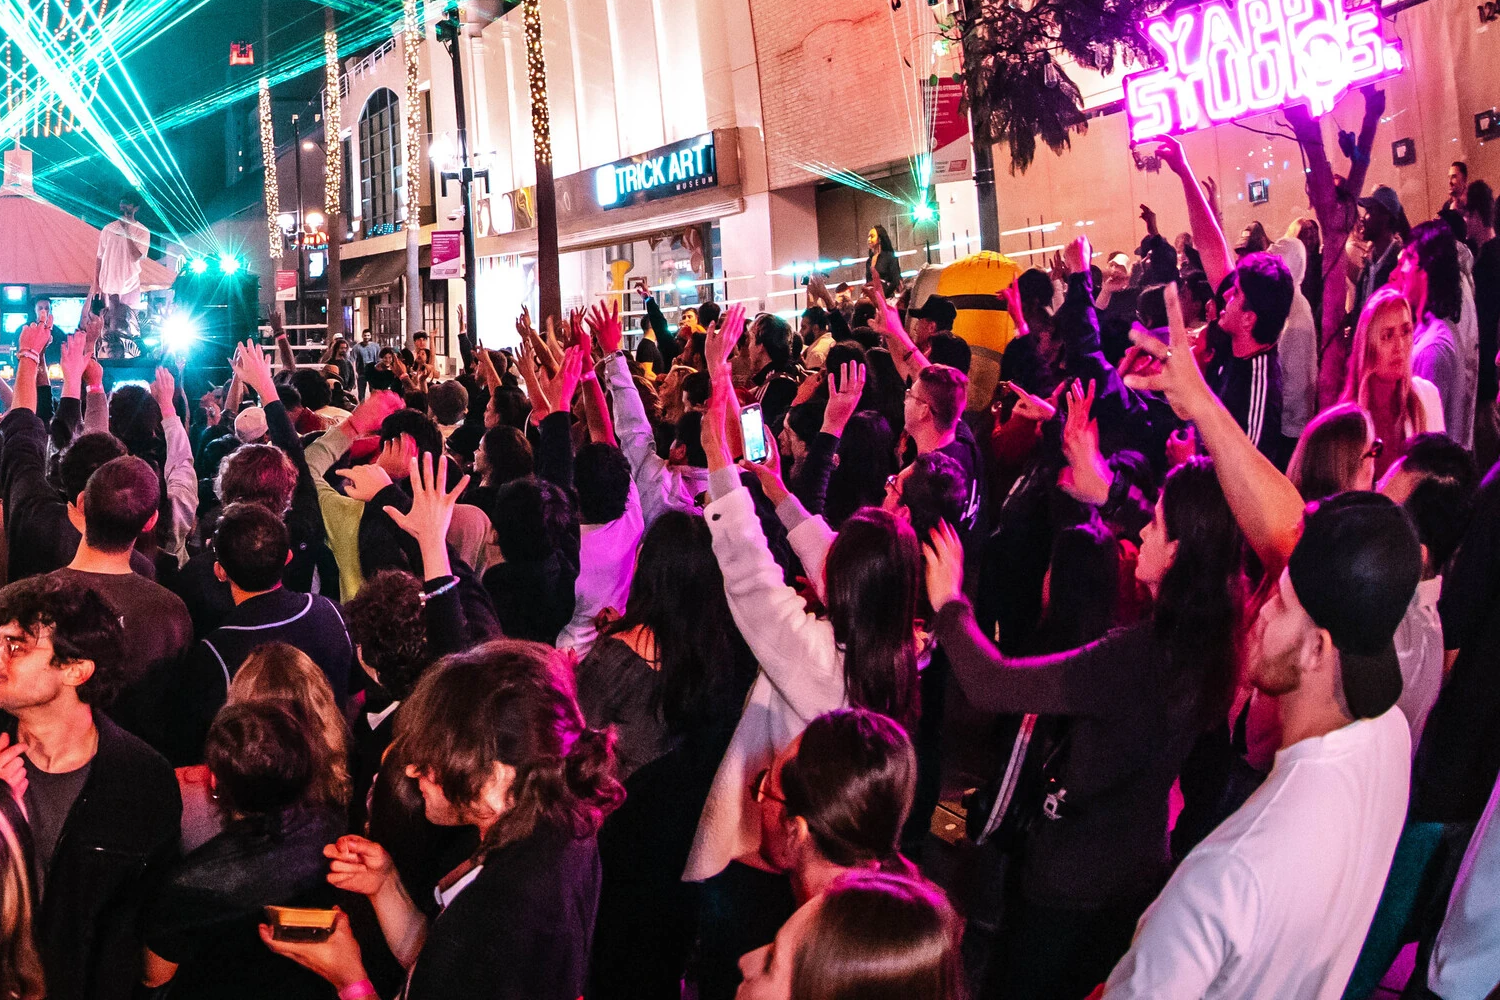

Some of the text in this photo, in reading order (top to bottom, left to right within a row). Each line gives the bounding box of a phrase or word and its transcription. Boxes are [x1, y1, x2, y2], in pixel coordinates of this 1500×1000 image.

[615, 145, 706, 195] TRICK ART
[676, 176, 713, 191] MUSEUM
